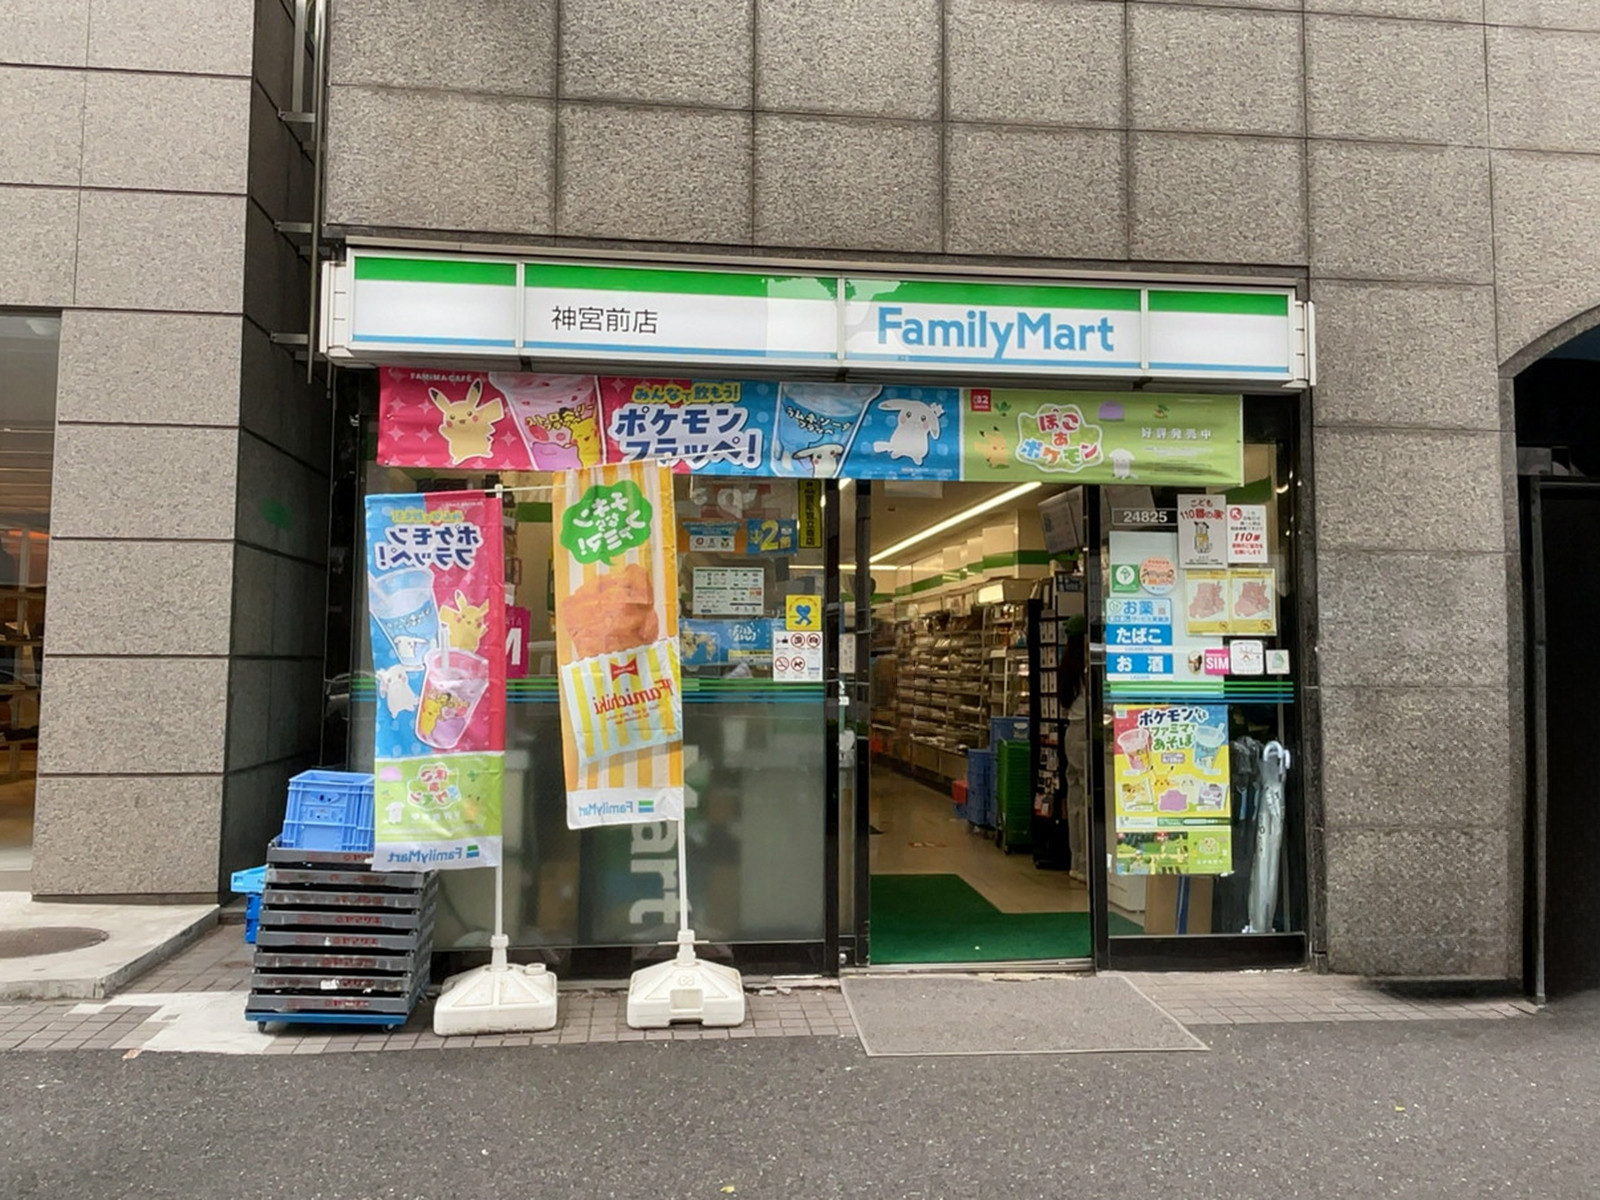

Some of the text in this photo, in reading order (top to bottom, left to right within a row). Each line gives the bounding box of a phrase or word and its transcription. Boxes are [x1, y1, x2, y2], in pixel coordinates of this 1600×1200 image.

[551, 305, 658, 335] 神宮前店
[878, 307, 1115, 360] FamilyMart
[614, 405, 742, 437] ポケモン
[1020, 439, 1099, 465] ポケモン
[1123, 510, 1168, 523] 24825
[1123, 600, 1154, 615] お薬
[1116, 627, 1162, 643] たばこ
[1116, 655, 1164, 672] お酒
[1206, 657, 1229, 671] SIM
